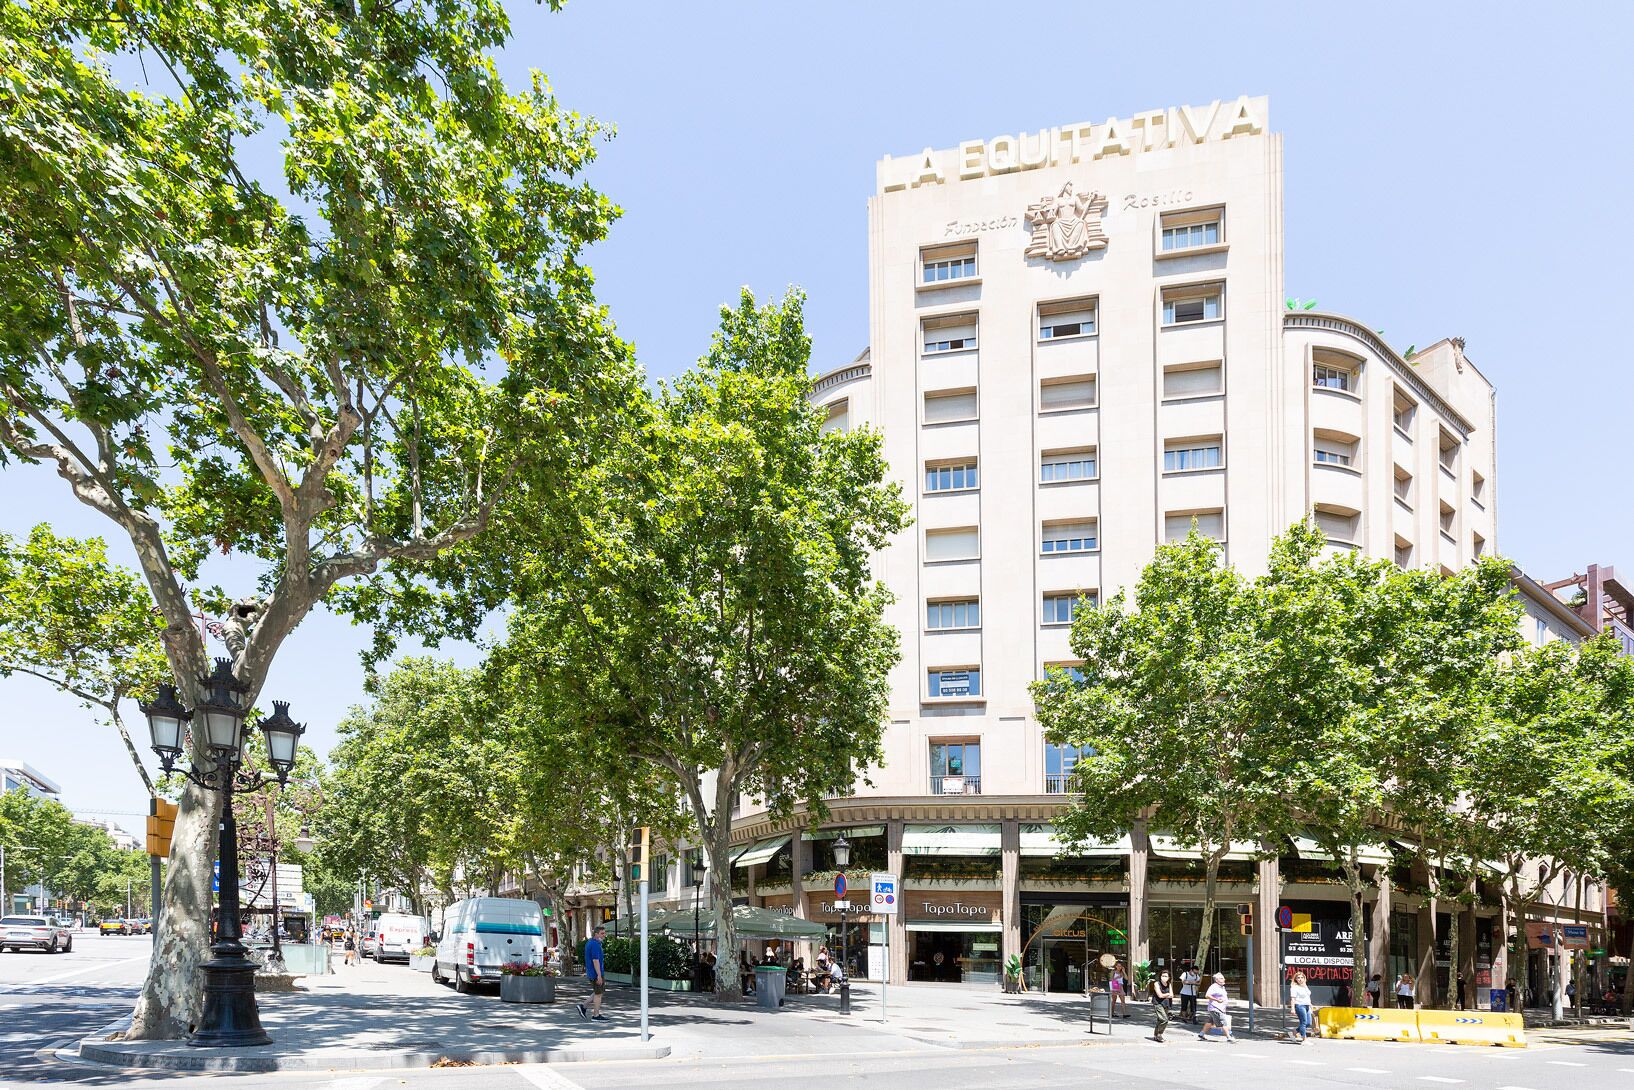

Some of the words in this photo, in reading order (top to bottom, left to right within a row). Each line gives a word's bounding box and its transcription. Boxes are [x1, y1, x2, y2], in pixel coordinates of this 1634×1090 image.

[883, 147, 945, 193] LA
[959, 95, 1263, 181] EQUITATIVA
[944, 215, 1018, 237] Fundación
[1123, 188, 1193, 211] Rosillo
[820, 902, 871, 914] Tapapa
[922, 902, 987, 916] TapaTapa
[1053, 929, 1086, 937] citrus
[1285, 966, 1354, 980] ANTICAPITALIST
